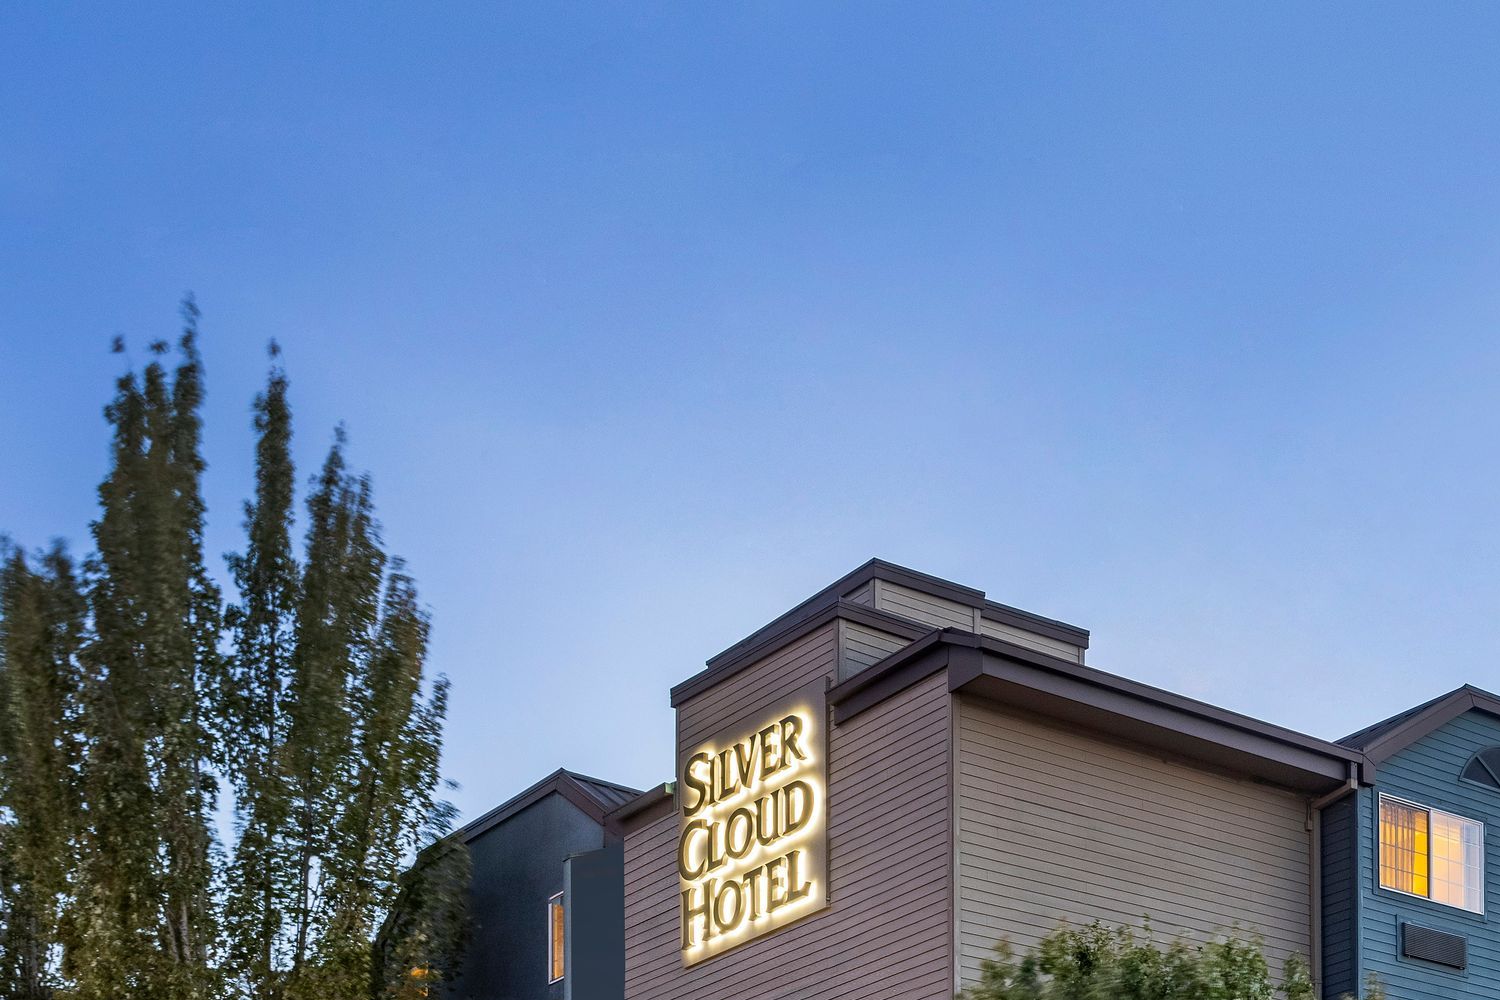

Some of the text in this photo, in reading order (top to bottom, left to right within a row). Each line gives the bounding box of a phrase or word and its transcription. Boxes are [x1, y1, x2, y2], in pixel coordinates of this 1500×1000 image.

[682, 714, 807, 817] SILVER
[678, 780, 815, 881] CLOUD
[681, 850, 812, 950] HOTEL
